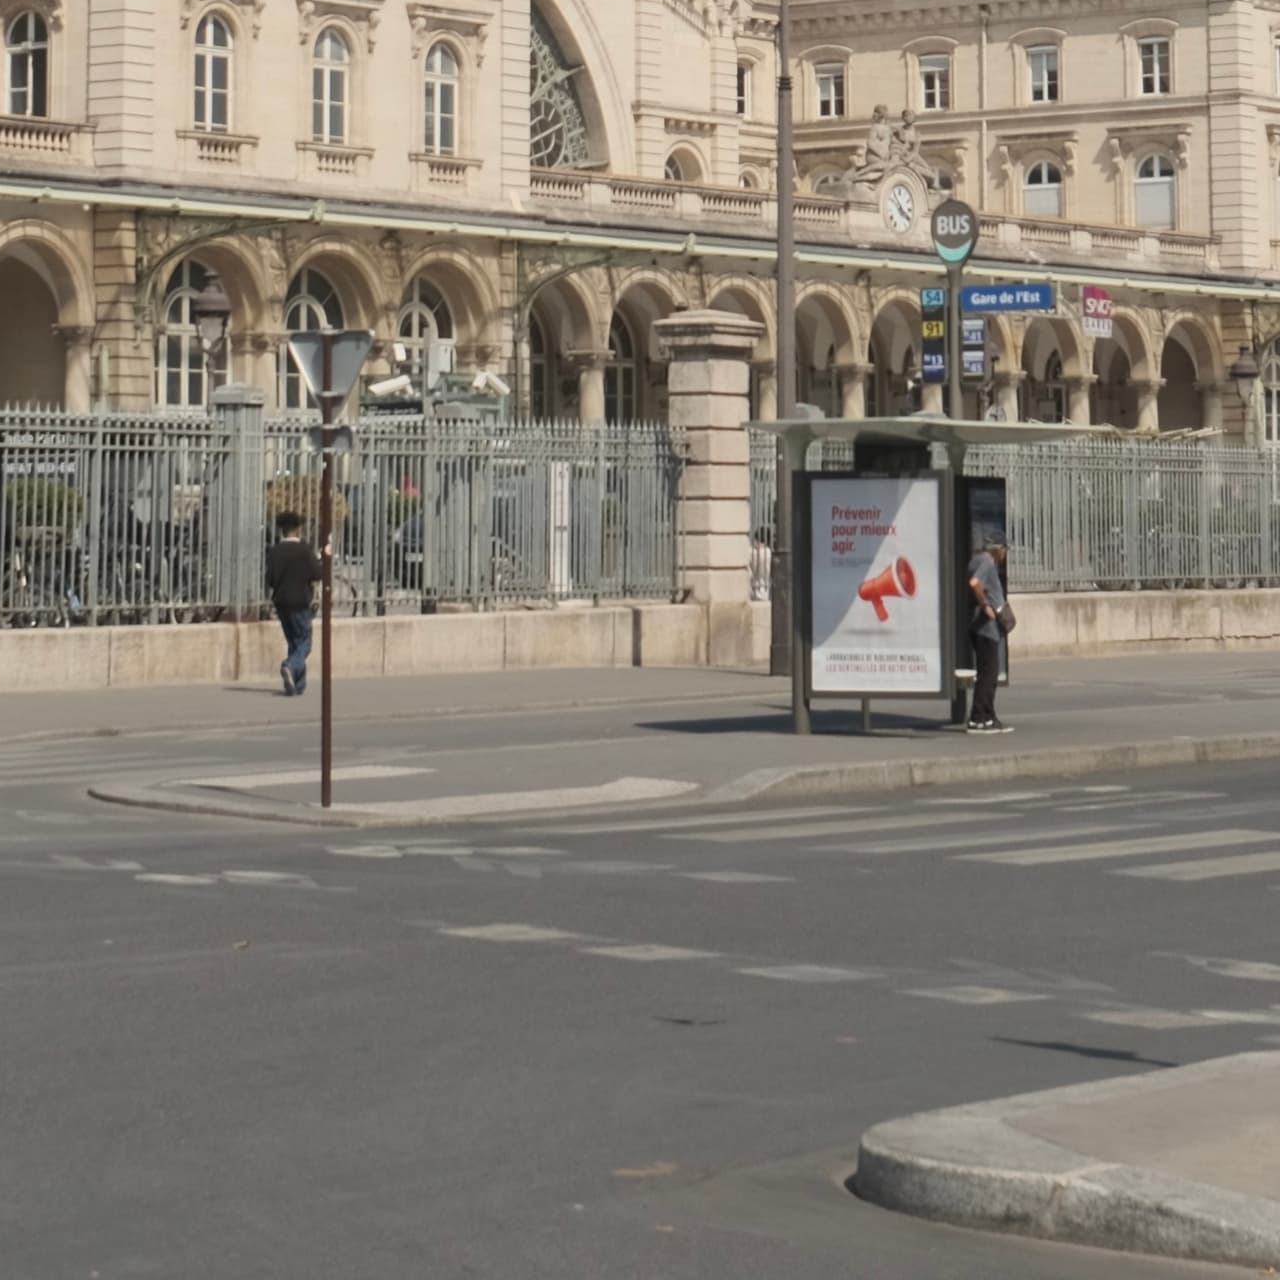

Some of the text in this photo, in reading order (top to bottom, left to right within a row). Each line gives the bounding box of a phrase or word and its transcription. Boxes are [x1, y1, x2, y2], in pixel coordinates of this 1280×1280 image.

[936, 215, 970, 235] BUS
[925, 291, 941, 304] 54
[971, 291, 1040, 305] Gare de l'Est
[925, 323, 941, 336] 91
[831, 505, 881, 520] Prévenir
[831, 521, 897, 538] pour mieux
[831, 538, 856, 554] agir.
